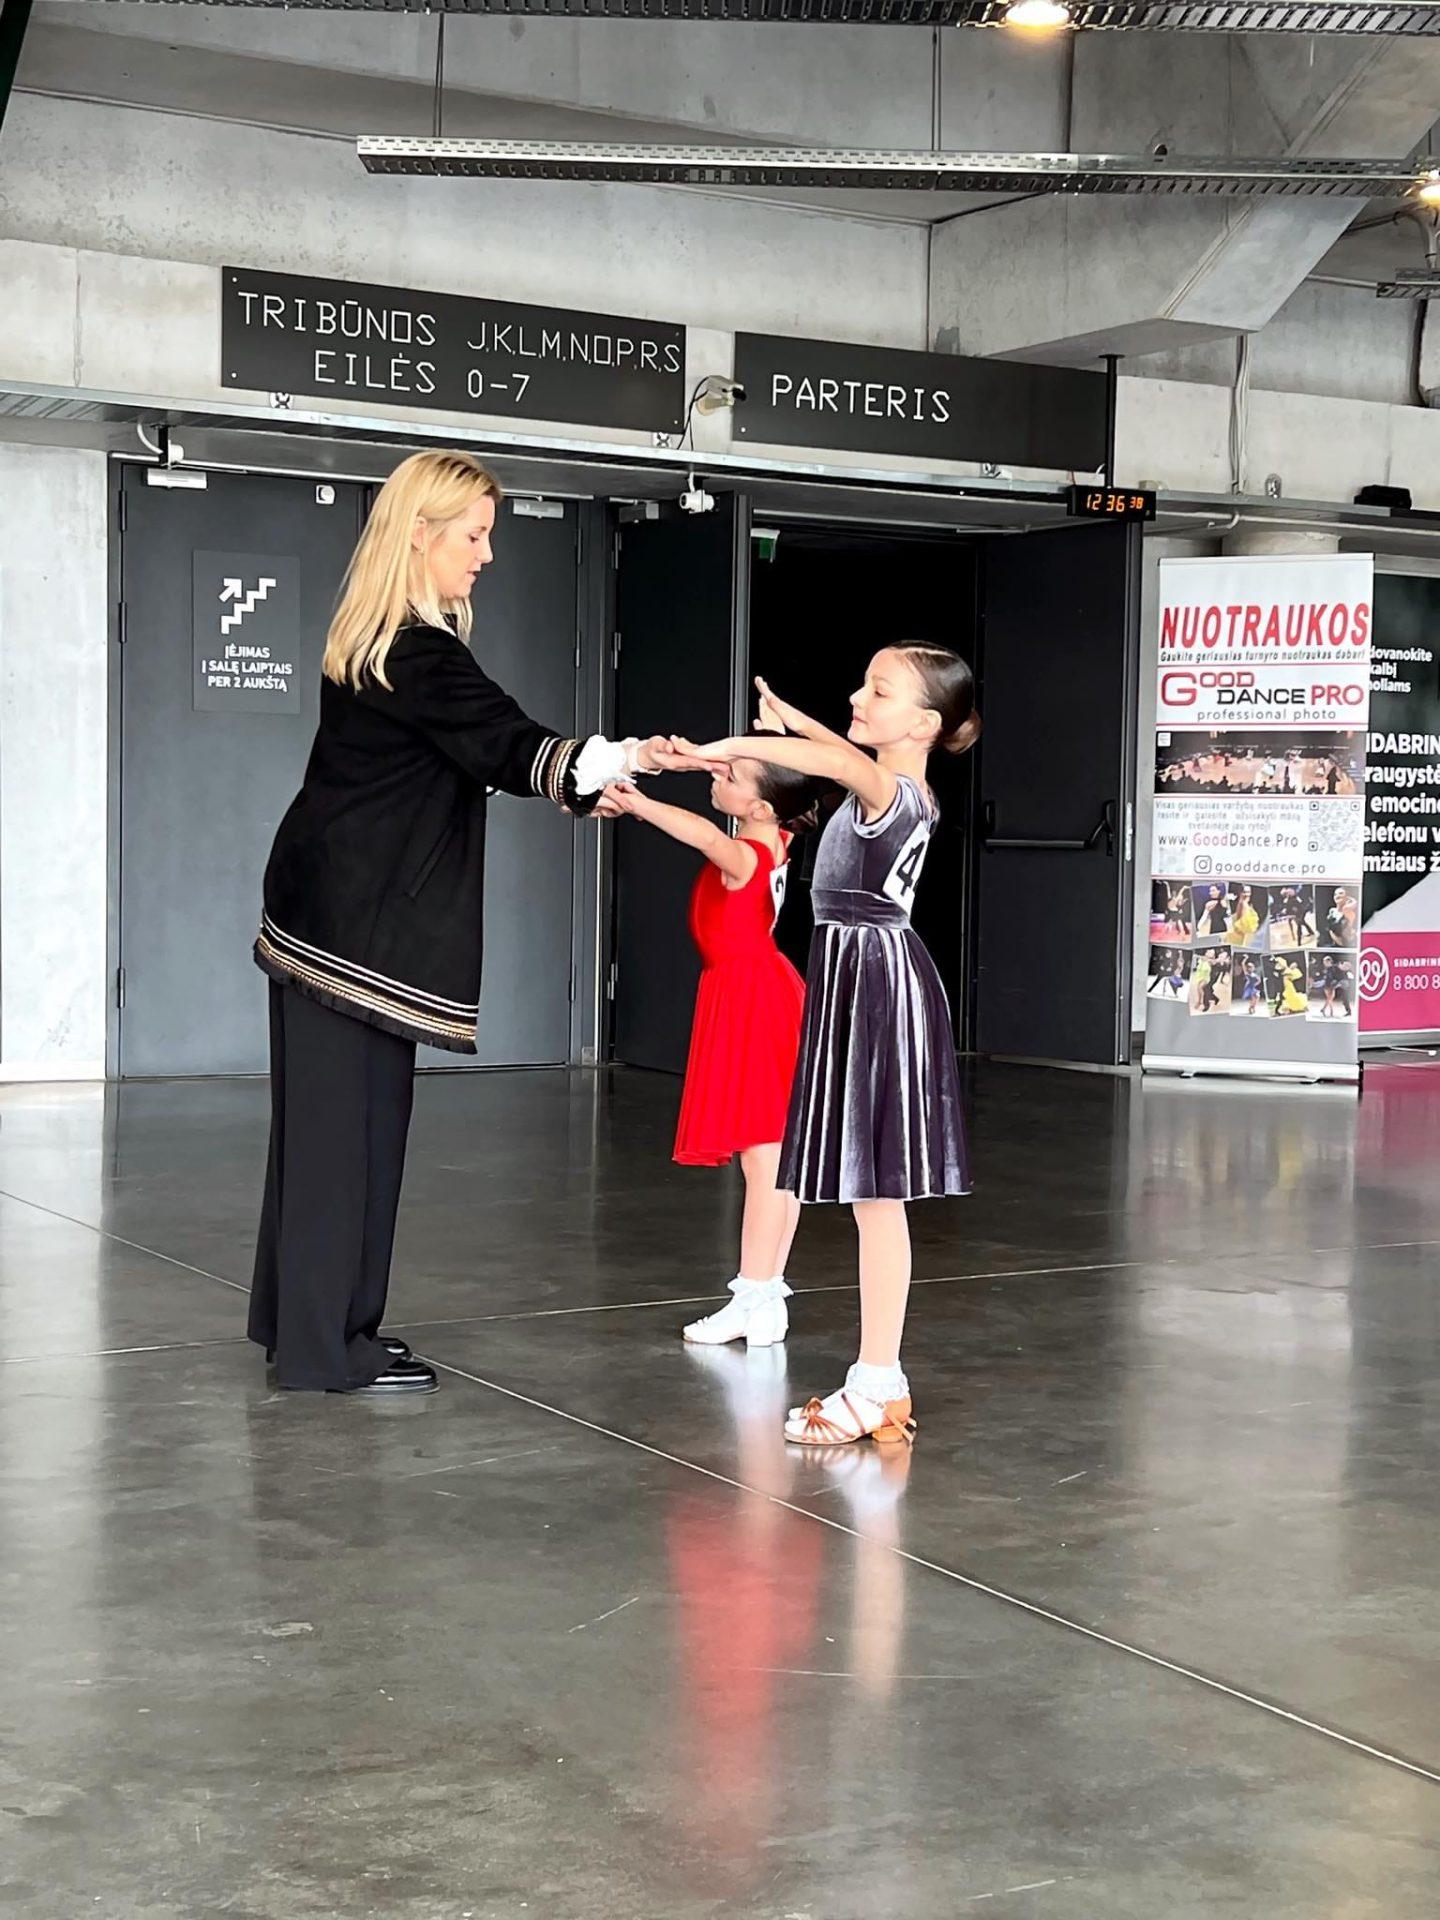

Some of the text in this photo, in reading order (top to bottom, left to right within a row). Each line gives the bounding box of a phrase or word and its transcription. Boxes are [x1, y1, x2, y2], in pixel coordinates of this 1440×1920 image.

[238, 291, 436, 346] TRIBŪNOS
[314, 349, 436, 394] EILĖS
[772, 374, 950, 423] PARTERIS
[1086, 493, 1102, 510] 12
[1106, 494, 1126, 512] 36
[1160, 602, 1369, 649] NUOTRAUKOS
[224, 642, 271, 659] ĮĖJIMAS
[1160, 651, 1193, 662] Gaukite
[1196, 651, 1242, 664] geriausias
[1245, 651, 1278, 663] turnyro
[1281, 649, 1331, 660] nuotraukas
[208, 660, 240, 675] SALĘ
[241, 661, 293, 675] LAIPTAIS
[207, 675, 287, 692] PER 2 AUKŠTĄ
[1161, 672, 1255, 706] GOOD
[1216, 685, 1364, 706] DANCE PRO
[1197, 708, 1337, 721] professional photo
[1158, 832, 1299, 848] www.GoodDance.Pro
[1215, 860, 1326, 875] gooddance.pro
[1404, 974, 1429, 990] 800
